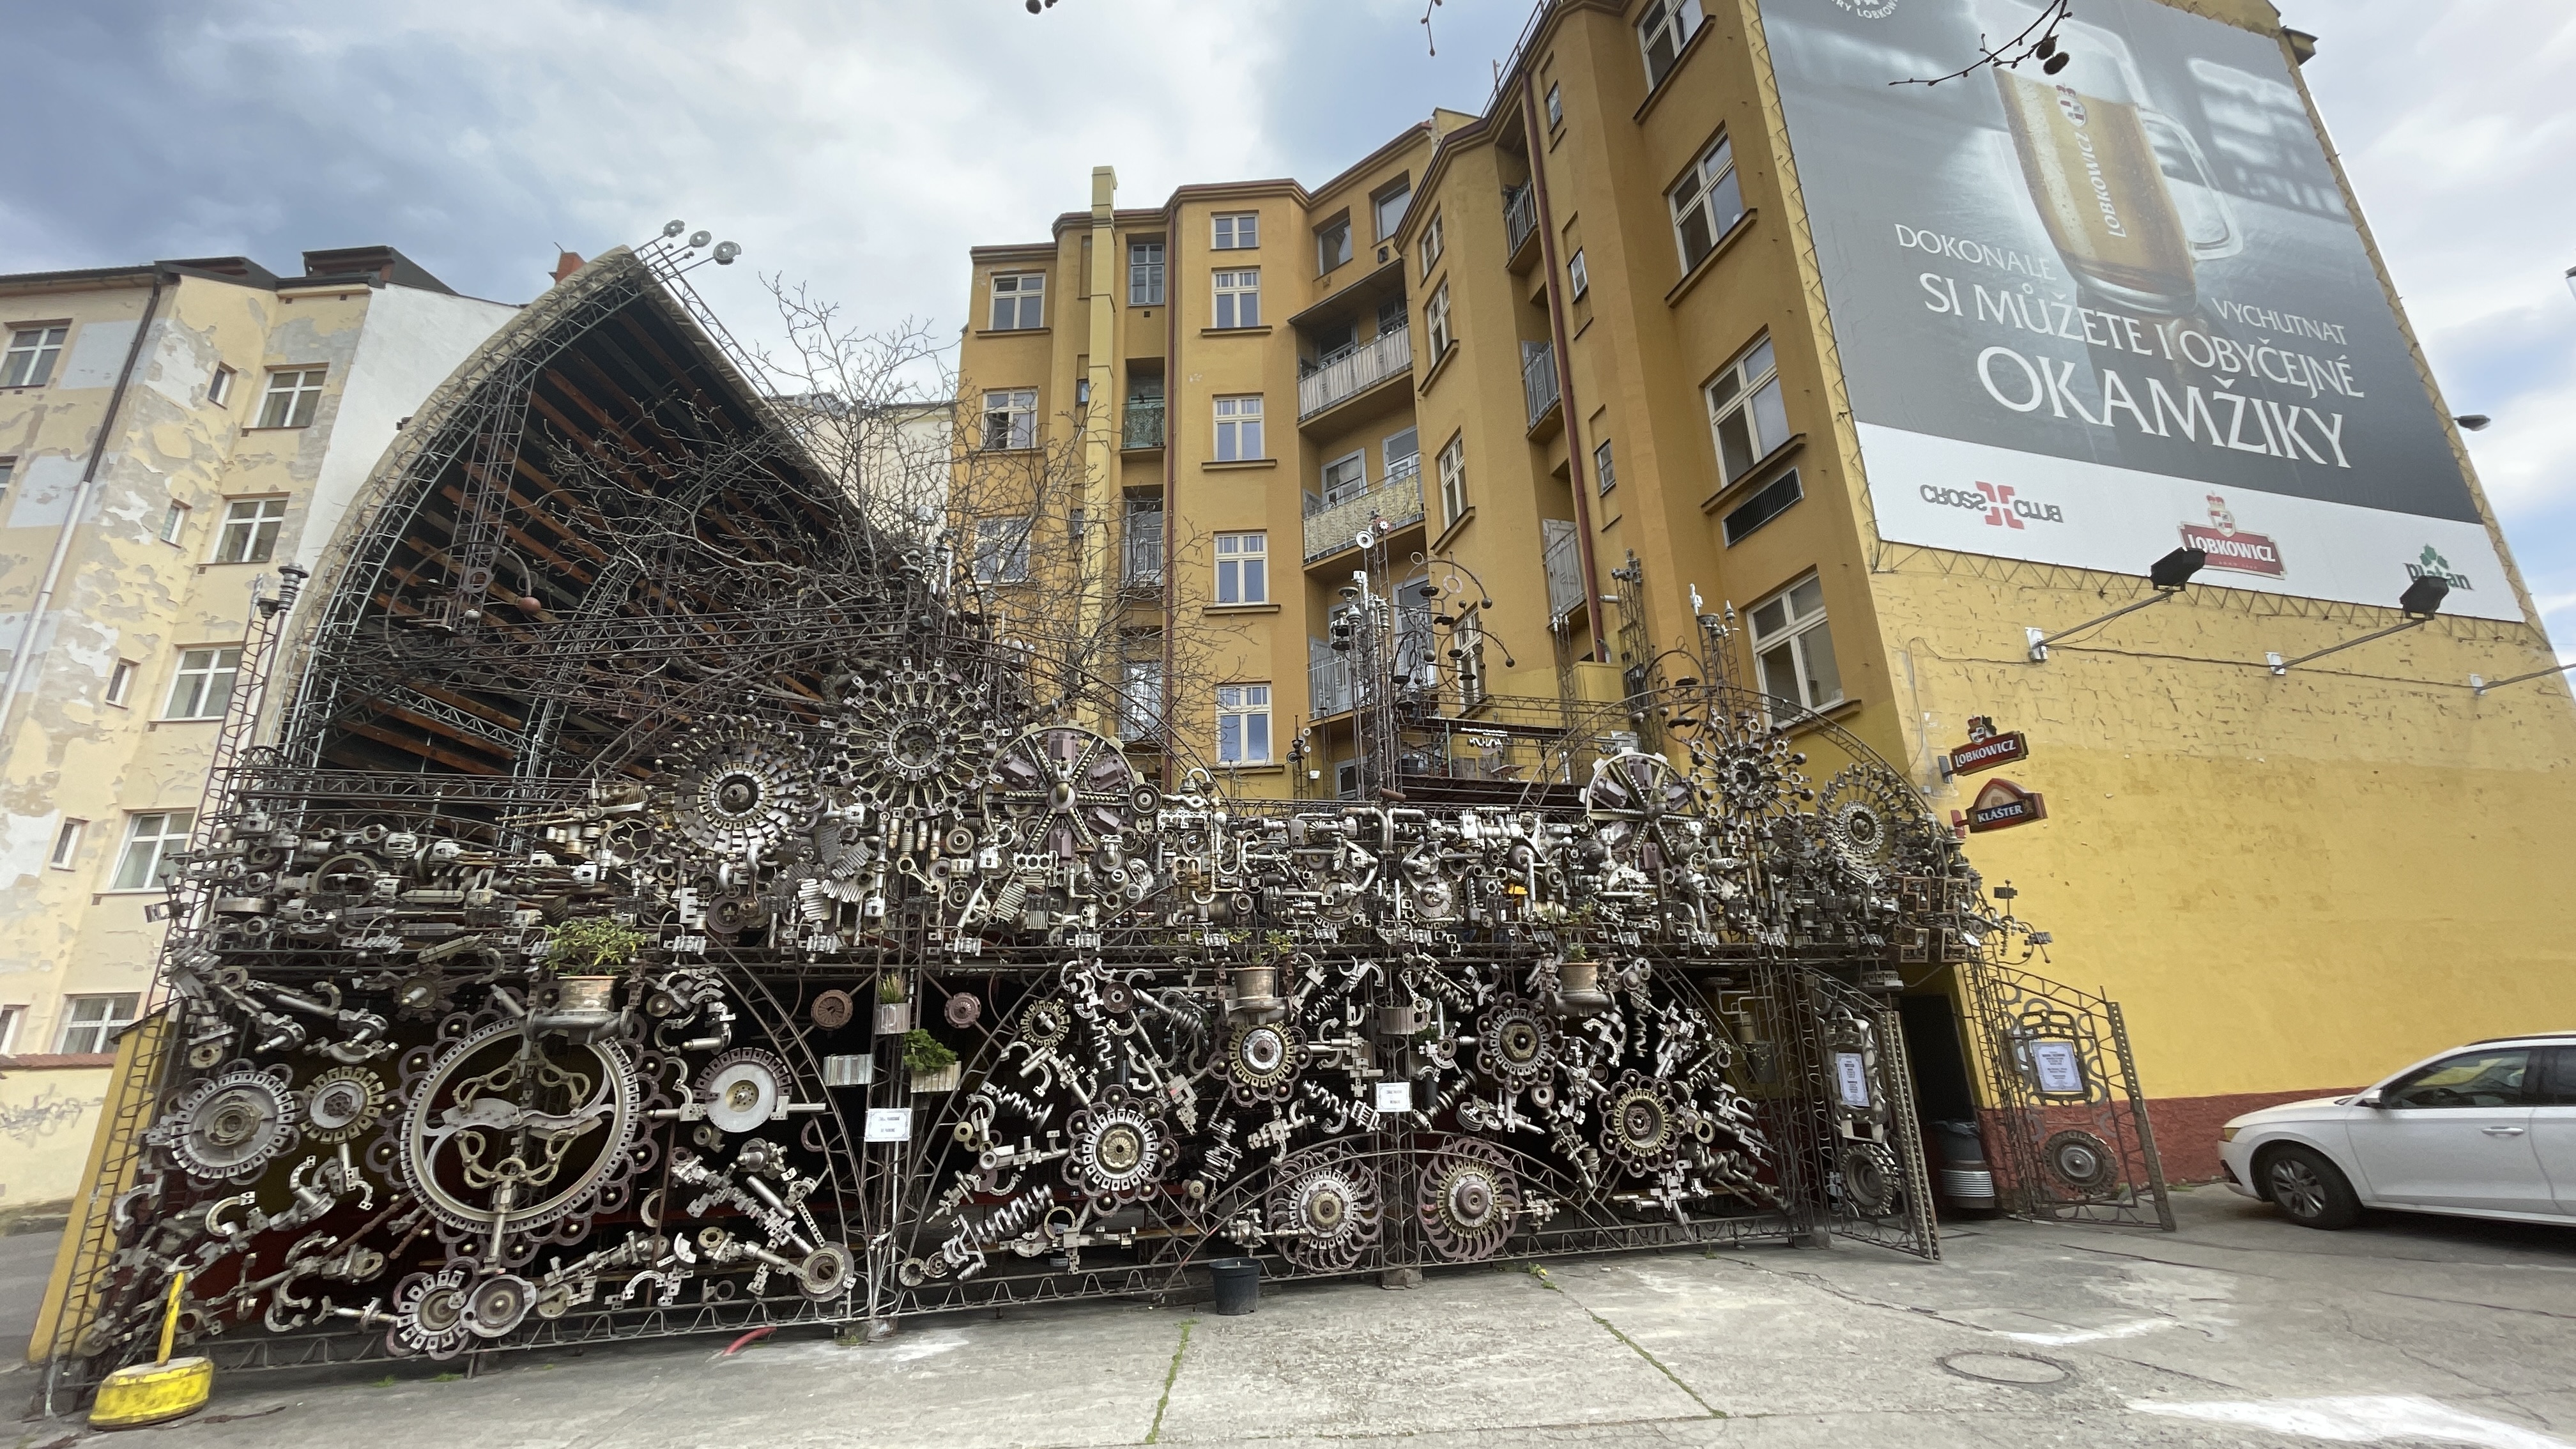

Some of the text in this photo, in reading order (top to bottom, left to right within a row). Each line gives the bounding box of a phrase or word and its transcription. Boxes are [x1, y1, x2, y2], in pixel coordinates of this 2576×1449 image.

[2074, 131, 2127, 238] LOBKOWICZ
[1894, 224, 2057, 281] DOKONALE
[1919, 272, 2365, 399] SI MŮŽETE I OBYČEJNÉ
[2211, 297, 2348, 346] VYCHUTNAT
[1977, 346, 2352, 469] OKAMŽIKY
[1954, 739, 2016, 768] LOBKOWICZ
[1977, 804, 2023, 823] KLÁŠTER
